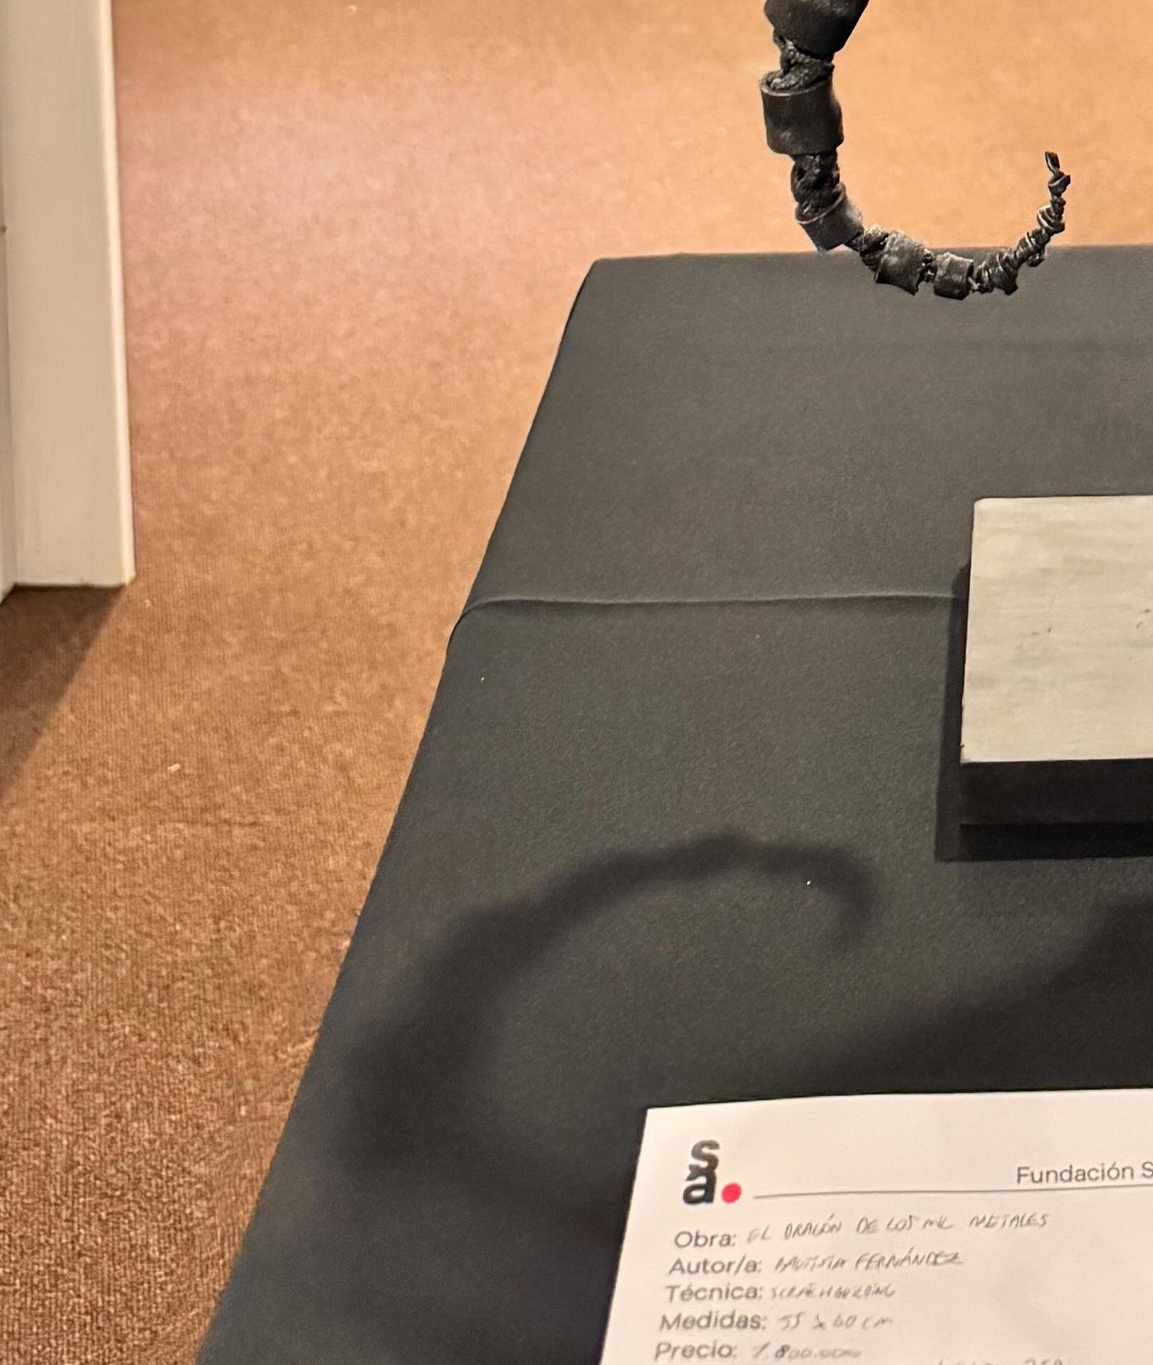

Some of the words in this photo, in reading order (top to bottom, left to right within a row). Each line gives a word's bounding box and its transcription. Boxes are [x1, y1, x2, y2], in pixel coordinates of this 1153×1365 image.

[1016, 1161, 1135, 1185] Fundación
[674, 1230, 736, 1249] Obra:
[856, 1216, 880, 1235] DE
[886, 1214, 916, 1233] LOS
[968, 1212, 1050, 1229] METALES
[668, 1254, 763, 1276] Autor/a:
[855, 1246, 965, 1271] FERNÁNDEZ
[665, 1282, 763, 1303] Técnica:
[659, 1309, 767, 1332] Medidas:
[654, 1339, 738, 1363] Precio:
